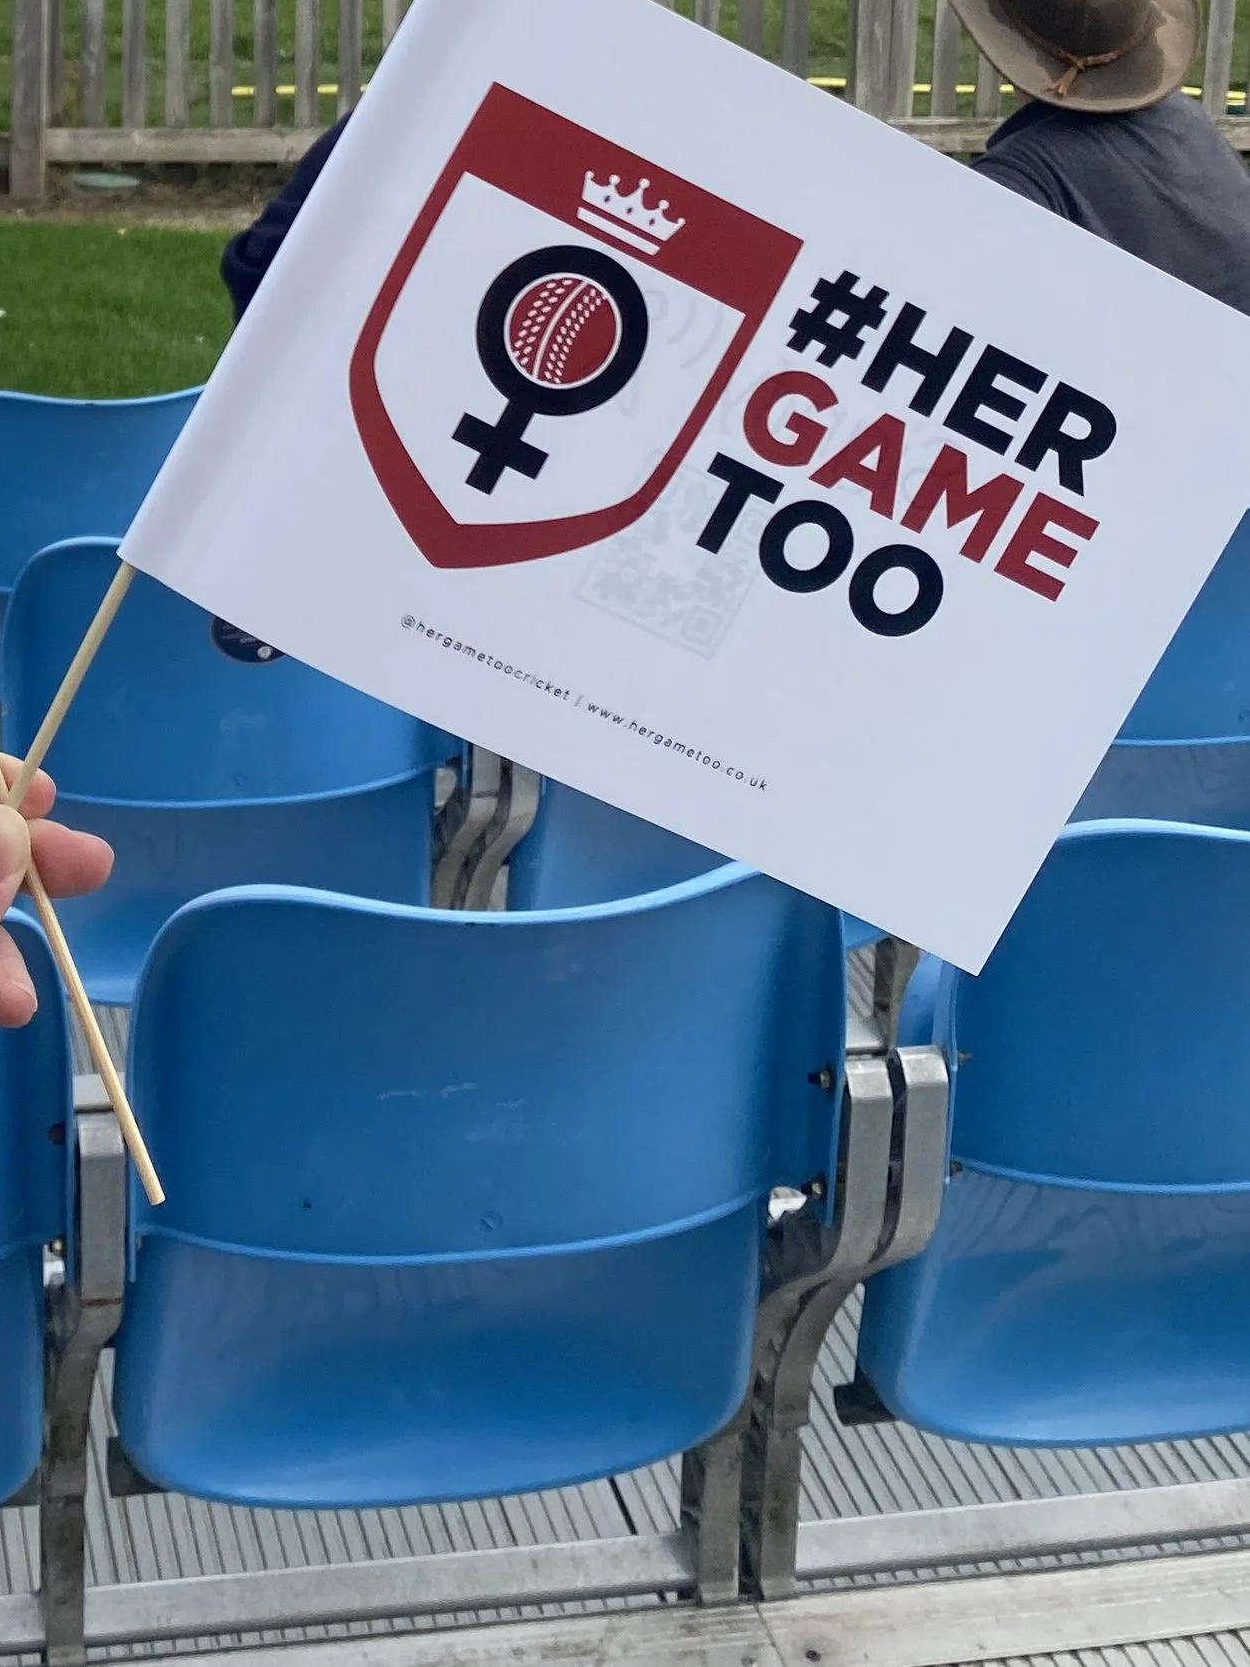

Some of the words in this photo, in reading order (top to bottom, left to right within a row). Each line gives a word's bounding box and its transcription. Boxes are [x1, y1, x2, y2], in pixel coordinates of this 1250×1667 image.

[743, 370, 1100, 602] GAME
[787, 271, 1117, 496] #HER
[696, 452, 944, 637] TOO
[400, 613, 571, 702] @hergametoocricket
[586, 701, 768, 793] www.hergametoo.co.uk
